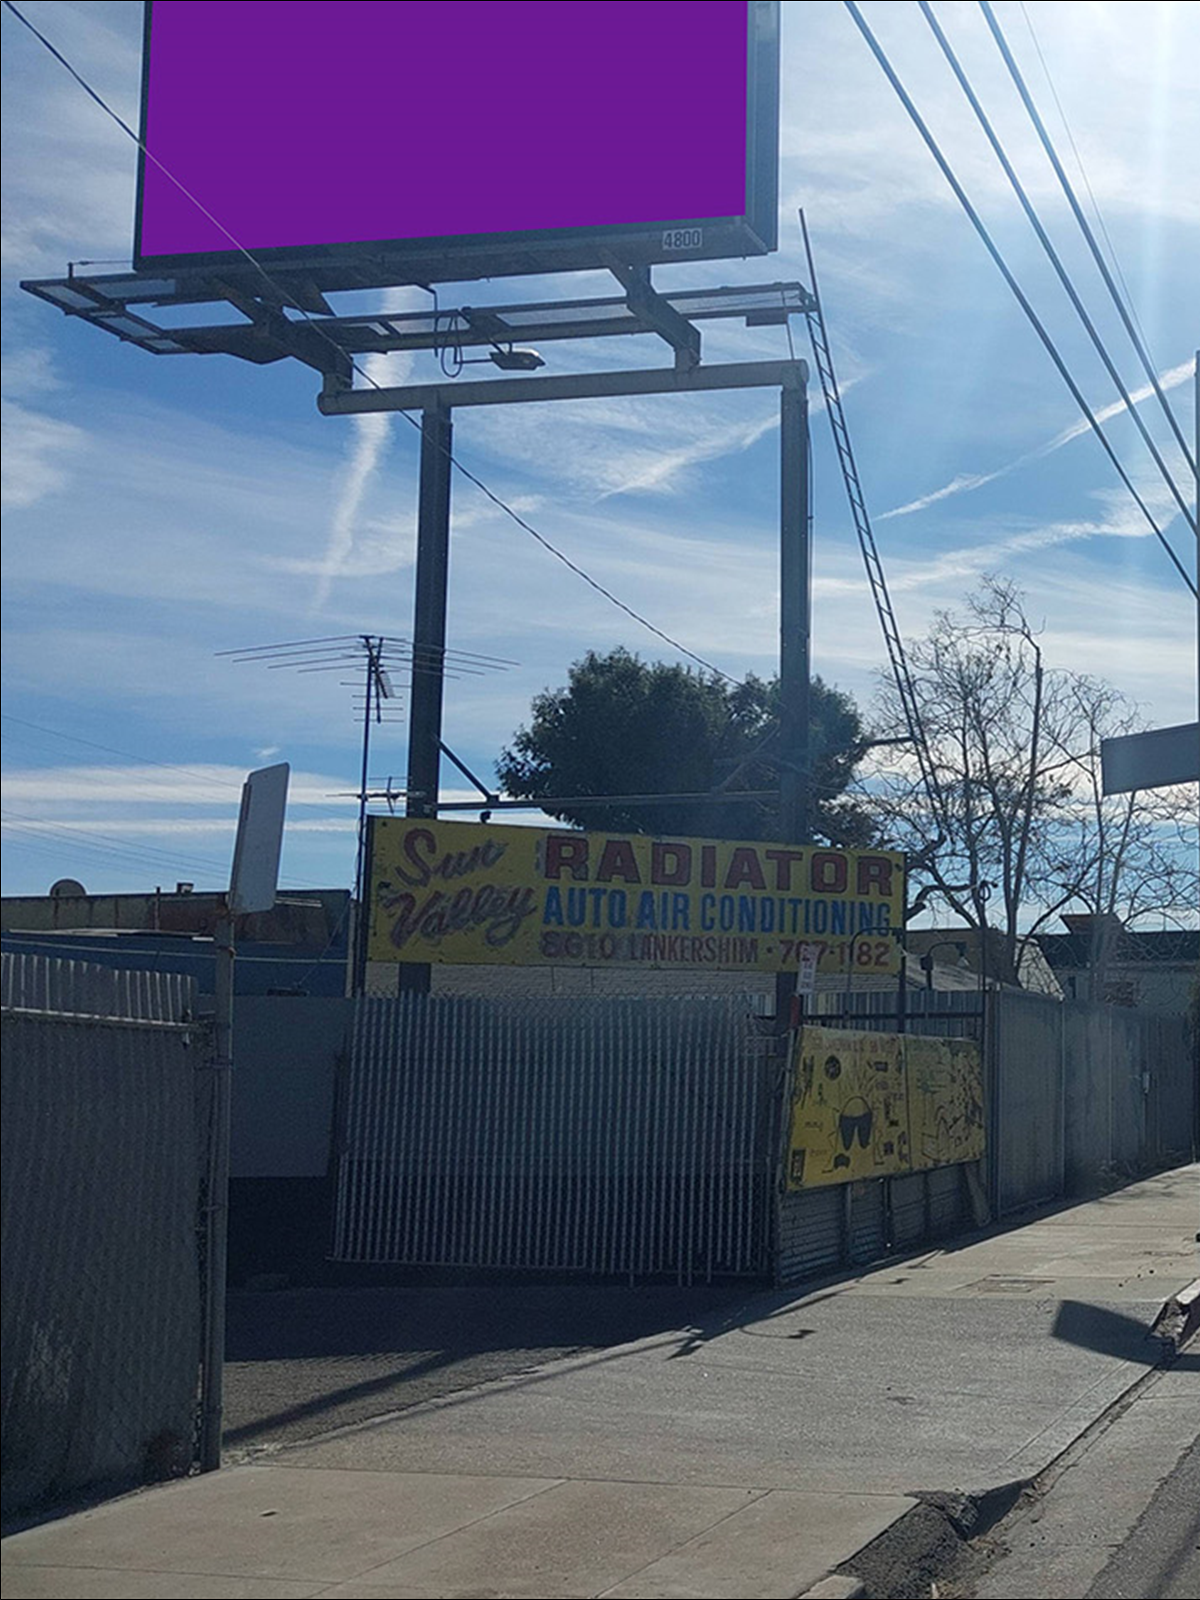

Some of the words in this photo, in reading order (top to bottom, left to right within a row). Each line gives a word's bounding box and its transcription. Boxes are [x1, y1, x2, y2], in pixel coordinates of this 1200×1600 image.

[664, 229, 701, 248] 4800
[395, 828, 508, 888] Sun
[544, 835, 893, 897] RADIATOR
[382, 884, 538, 949] Valley
[542, 886, 627, 929] AUTO
[636, 890, 690, 931] AIR
[701, 893, 891, 937] CONDITIONING
[629, 933, 758, 964] LANKERSHIM
[779, 940, 890, 967] 767-182
